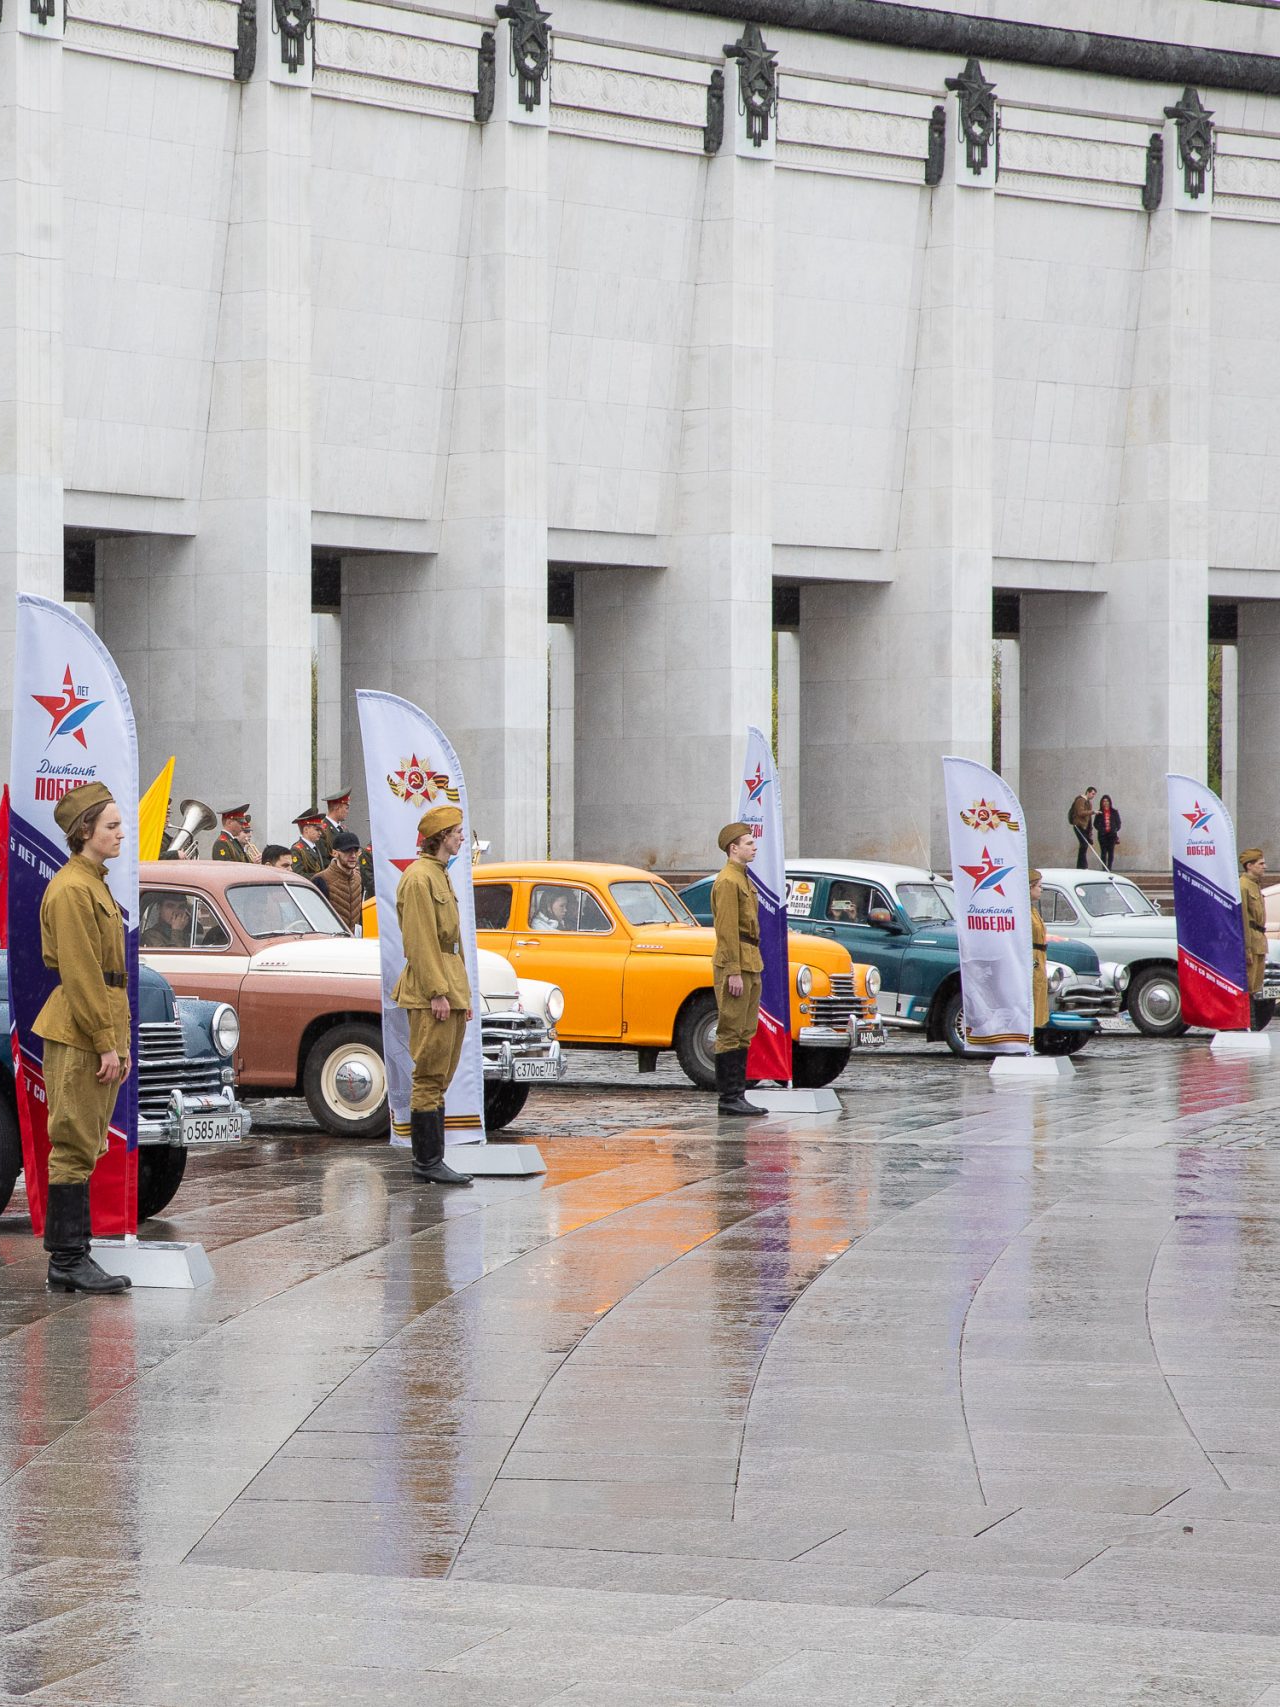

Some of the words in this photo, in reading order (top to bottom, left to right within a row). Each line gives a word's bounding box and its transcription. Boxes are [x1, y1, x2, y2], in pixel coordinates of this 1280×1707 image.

[56, 684, 73, 711] 5
[76, 685, 90, 697] ЛЕТ
[36, 758, 97, 777] Диктант
[35, 776, 96, 801] ПОБЕ
[17, 843, 37, 868] ЛЕТ
[1186, 845, 1216, 856] ПОБЕДЫ
[967, 904, 1014, 914] Диктант
[967, 915, 1015, 933] ПОБЕДЫ
[228, 1118, 239, 1133] 50
